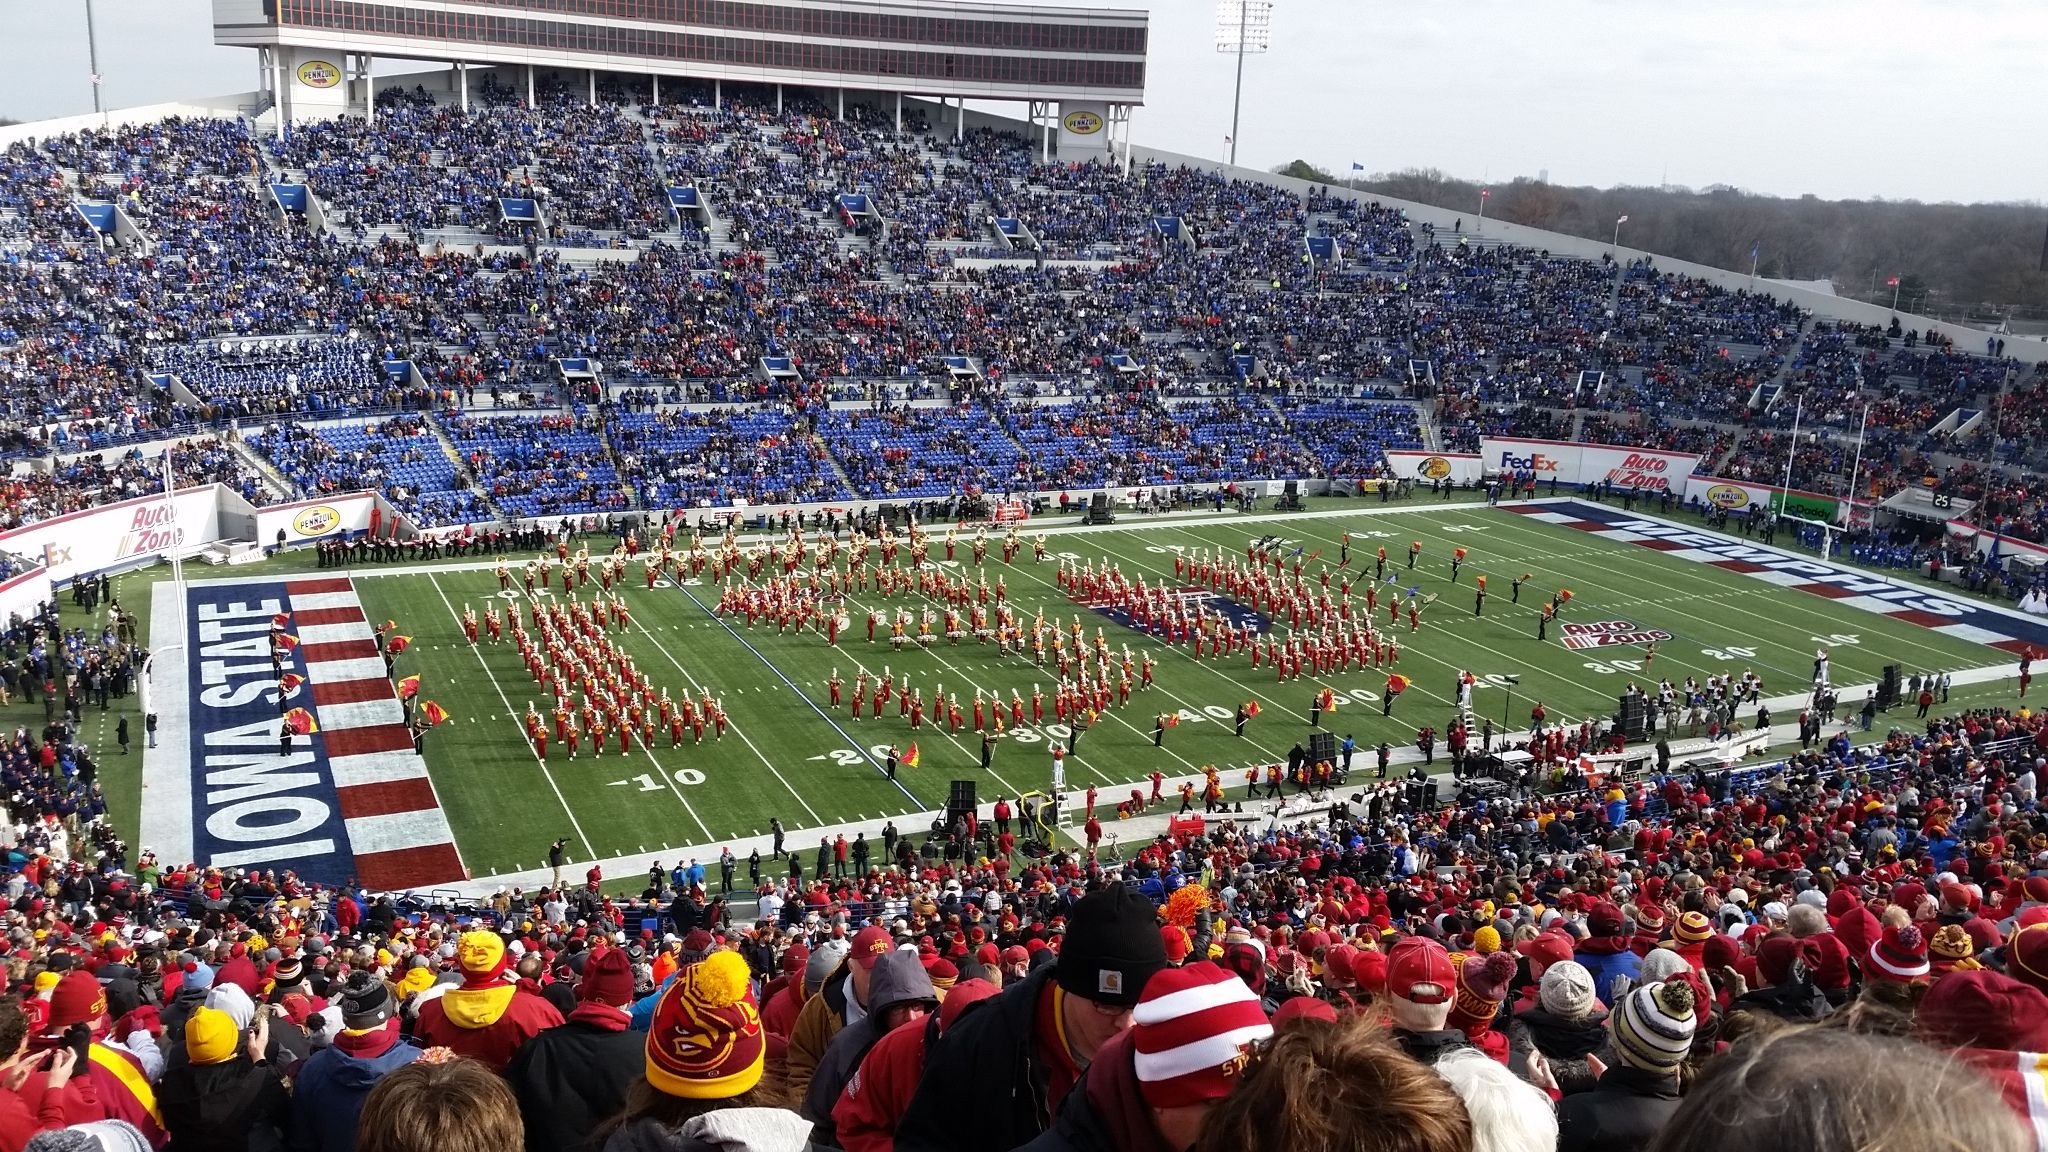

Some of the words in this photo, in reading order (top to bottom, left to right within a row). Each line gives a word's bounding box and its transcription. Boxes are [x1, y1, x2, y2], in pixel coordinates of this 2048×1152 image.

[303, 68, 335, 80] PENNZOIL
[1069, 118, 1098, 127] PENNZOIL
[1502, 451, 1558, 471] FedEx
[1621, 453, 1667, 472] Auto
[1620, 471, 1669, 489] Zone
[1712, 492, 1744, 501] PENNZOIL
[1935, 494, 1948, 508] 25
[300, 512, 334, 530] PENNZOIL
[1605, 520, 1976, 617] MEMPHIS
[1562, 621, 1636, 637] Auto
[1597, 629, 1672, 645] Zone
[1810, 634, 1860, 647] 10
[198, 599, 300, 708] STATE
[1702, 646, 1757, 660] 20
[1583, 660, 1643, 674] 30
[1179, 705, 1234, 723] 40
[1008, 724, 1073, 743] 30
[829, 744, 894, 766] 20
[631, 768, 706, 791] 10
[204, 717, 335, 868] IOWA
